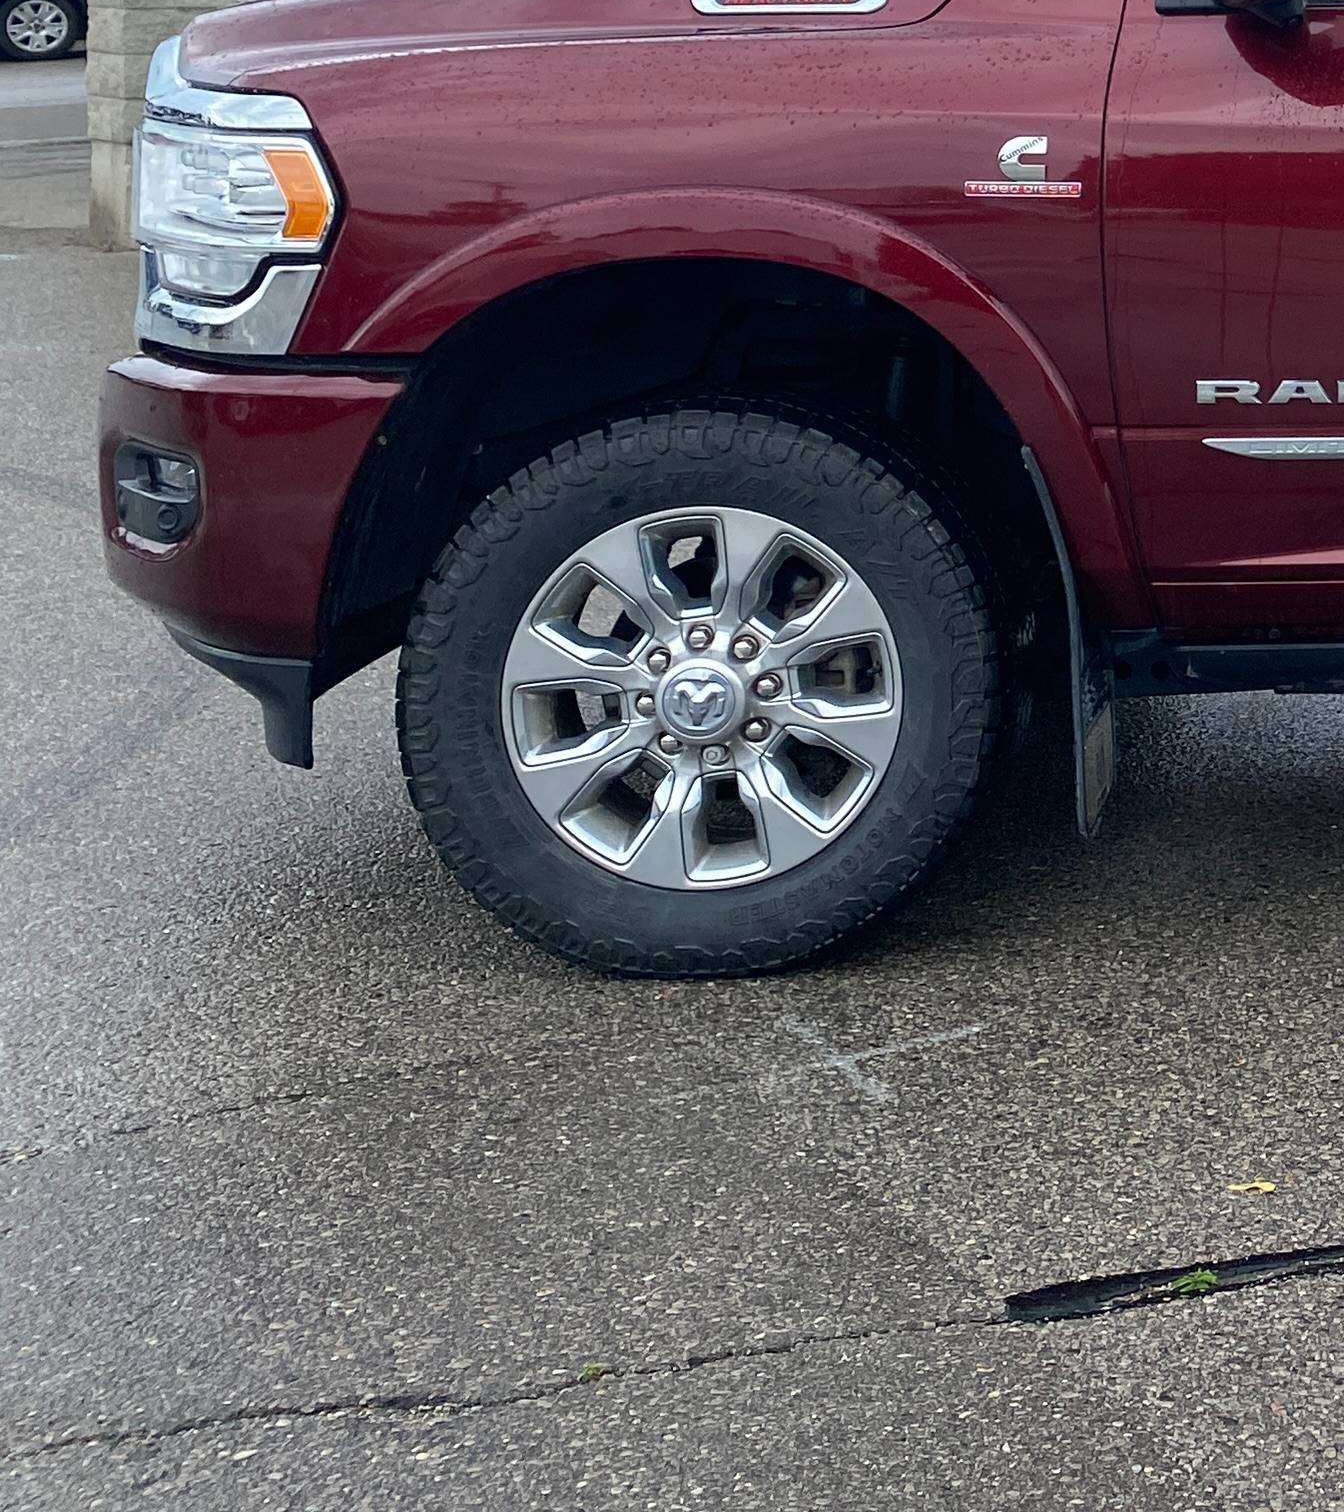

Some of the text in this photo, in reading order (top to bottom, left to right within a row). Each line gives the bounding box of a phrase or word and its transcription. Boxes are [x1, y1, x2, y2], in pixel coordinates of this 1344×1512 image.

[999, 136, 1044, 163] Cummins
[968, 183, 1078, 195] TURBO DIESEL
